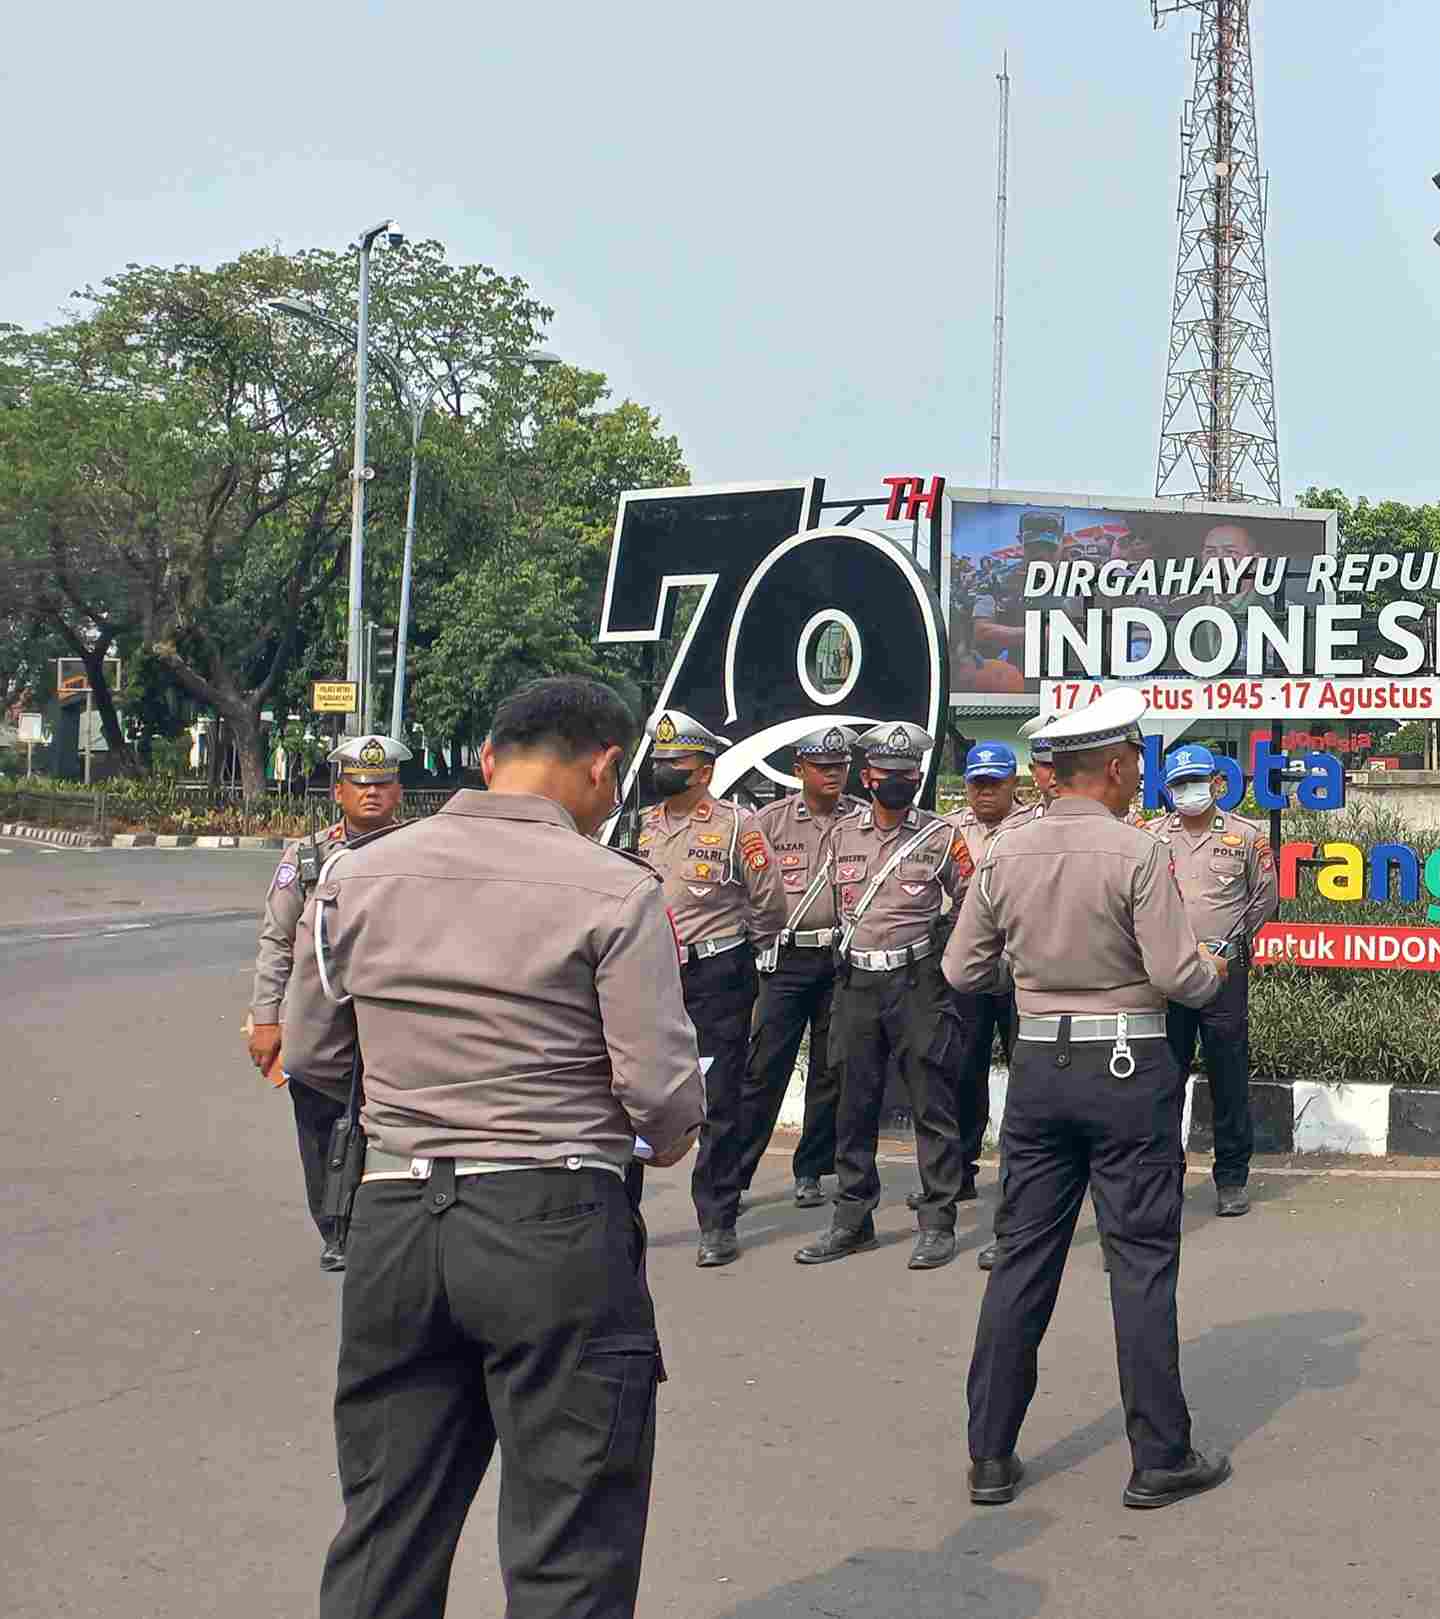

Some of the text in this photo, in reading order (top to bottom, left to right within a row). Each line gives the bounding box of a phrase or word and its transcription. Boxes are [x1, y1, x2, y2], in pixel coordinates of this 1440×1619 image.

[882, 474, 945, 520] TH
[1023, 555, 1288, 597] DIRGAHAYU
[1052, 684, 1080, 710] 17
[1203, 683, 1263, 710] 1945
[1319, 682, 1433, 714] Agustus
[687, 848, 722, 861] POLRI
